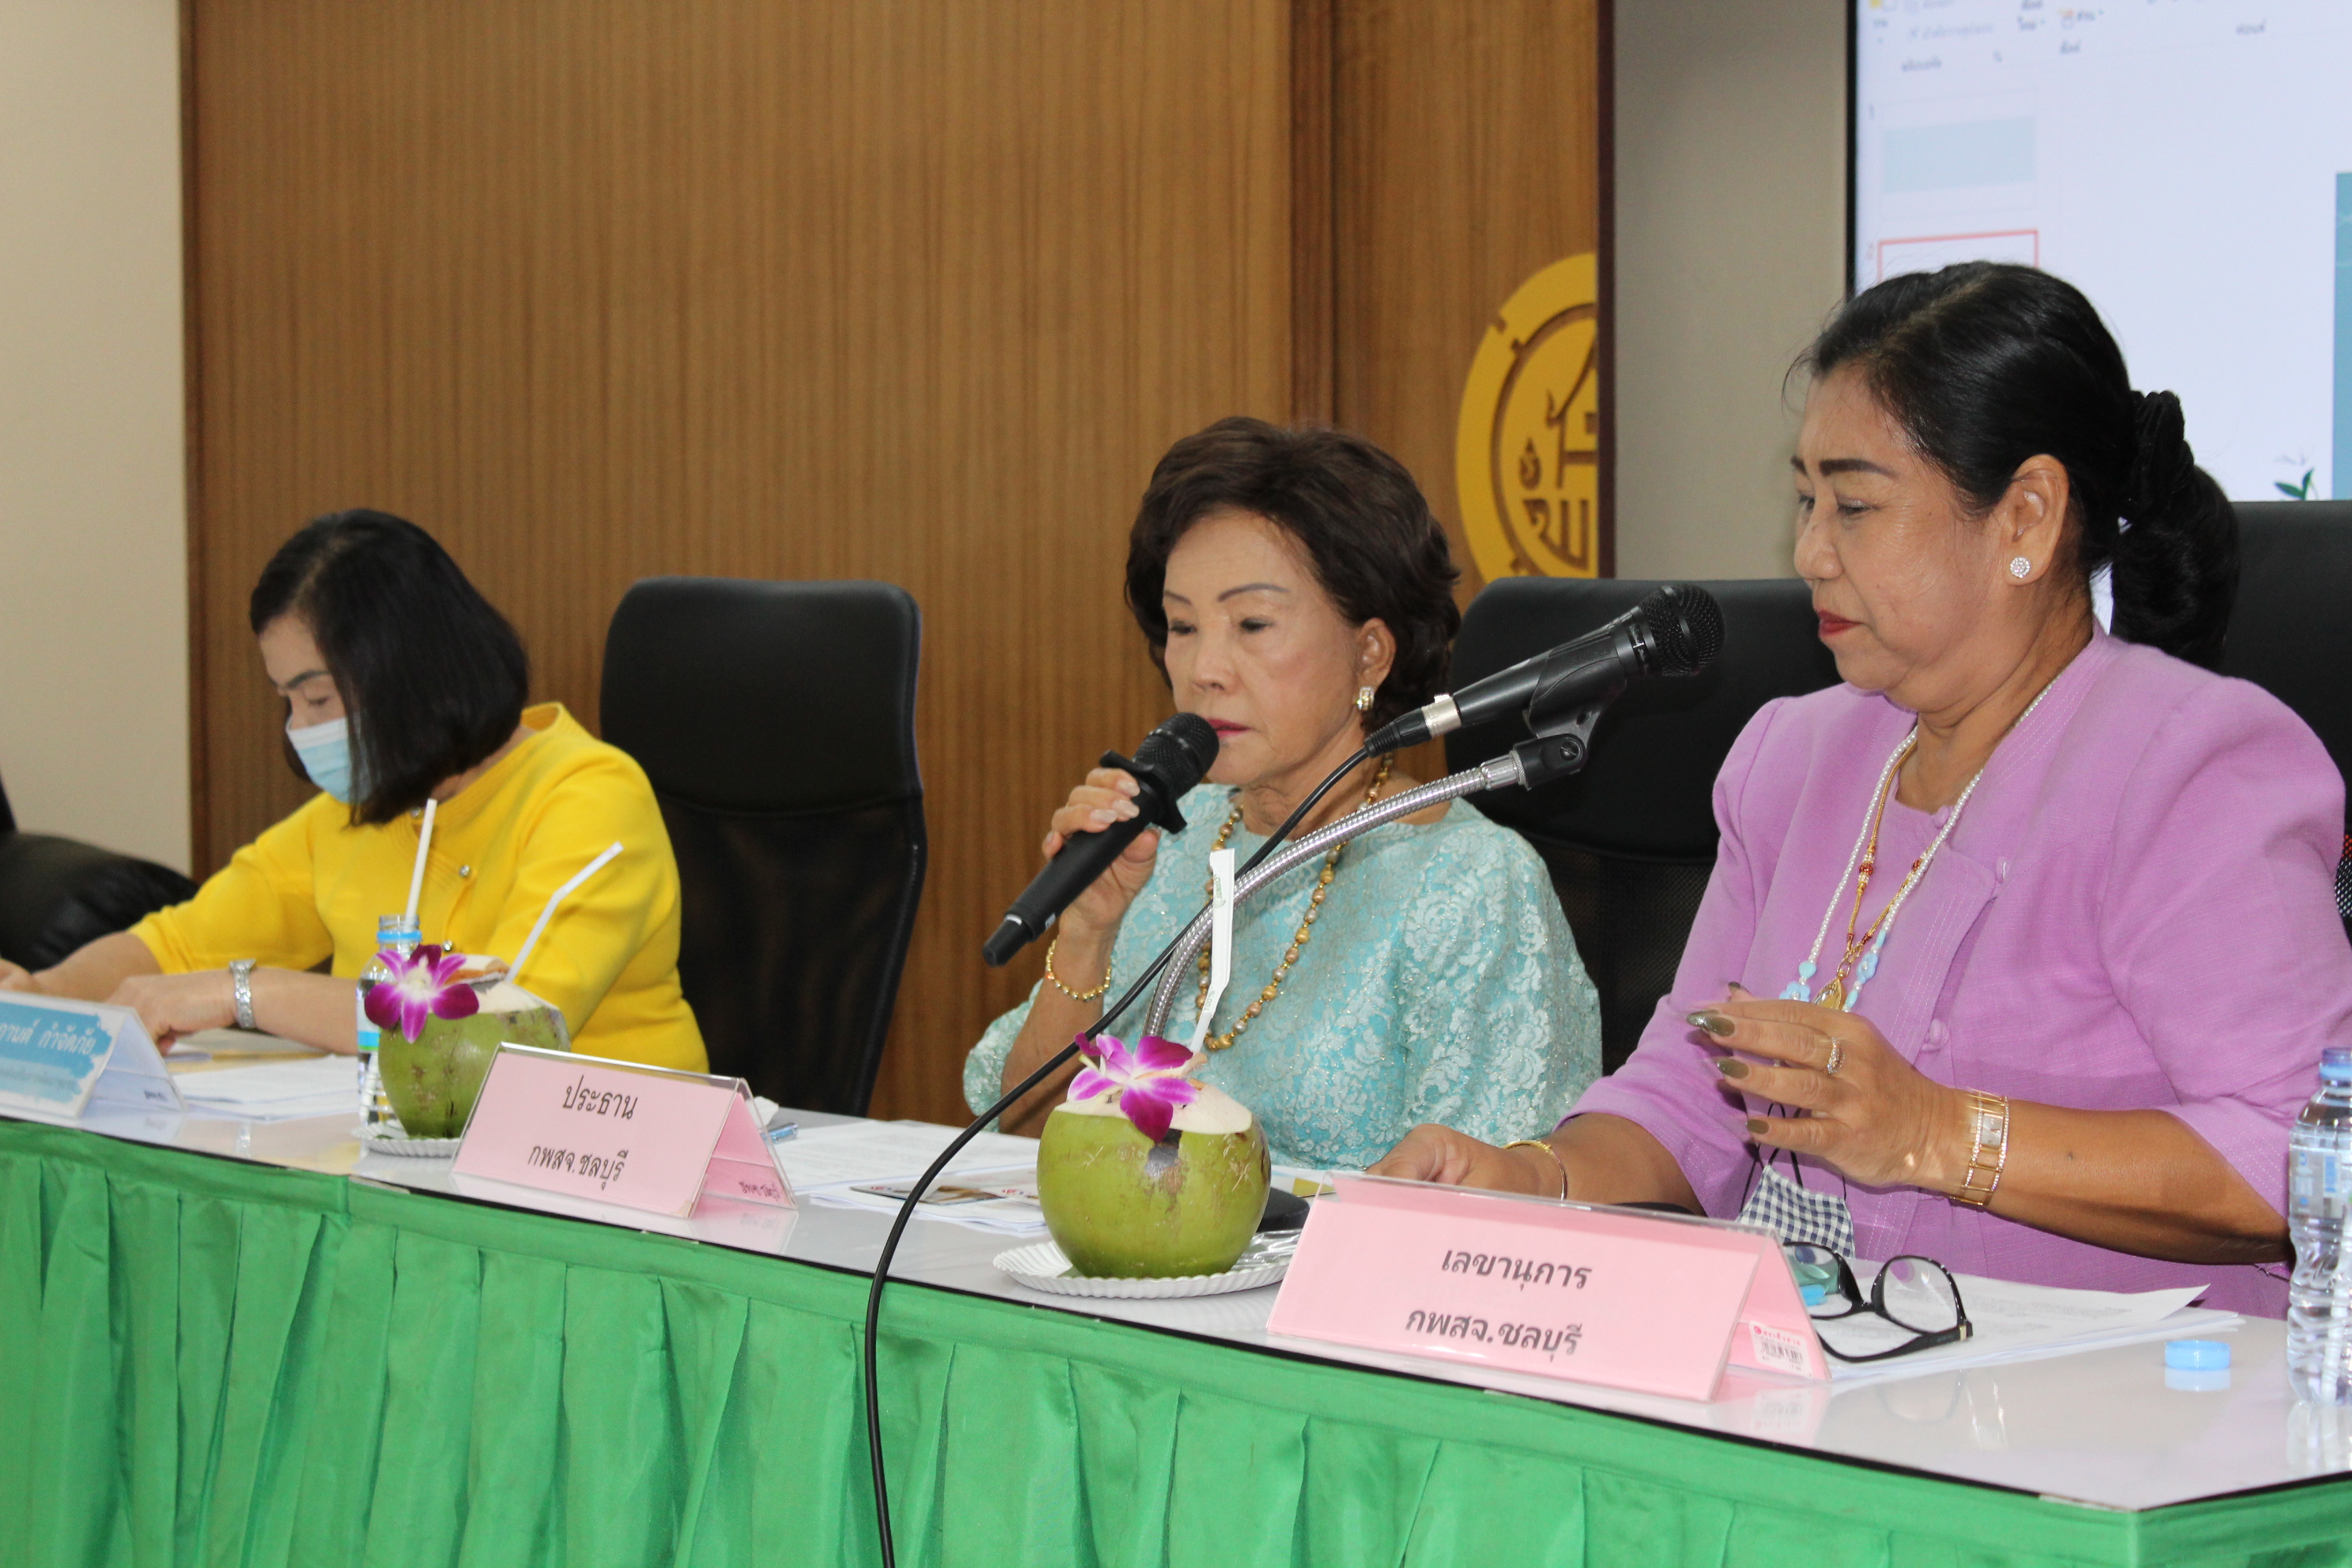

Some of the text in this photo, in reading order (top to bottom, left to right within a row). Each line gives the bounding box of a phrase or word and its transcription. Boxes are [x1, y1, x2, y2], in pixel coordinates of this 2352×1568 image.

[1203, 991, 1215, 1011] 100%
[562, 1075, 638, 1120] ประธาน
[527, 1145, 629, 1190] กพสจ.ชลบุรี
[1441, 1249, 1592, 1290] เลขานุการ
[1405, 1309, 1583, 1362] กพสจ.ชลบุรี
